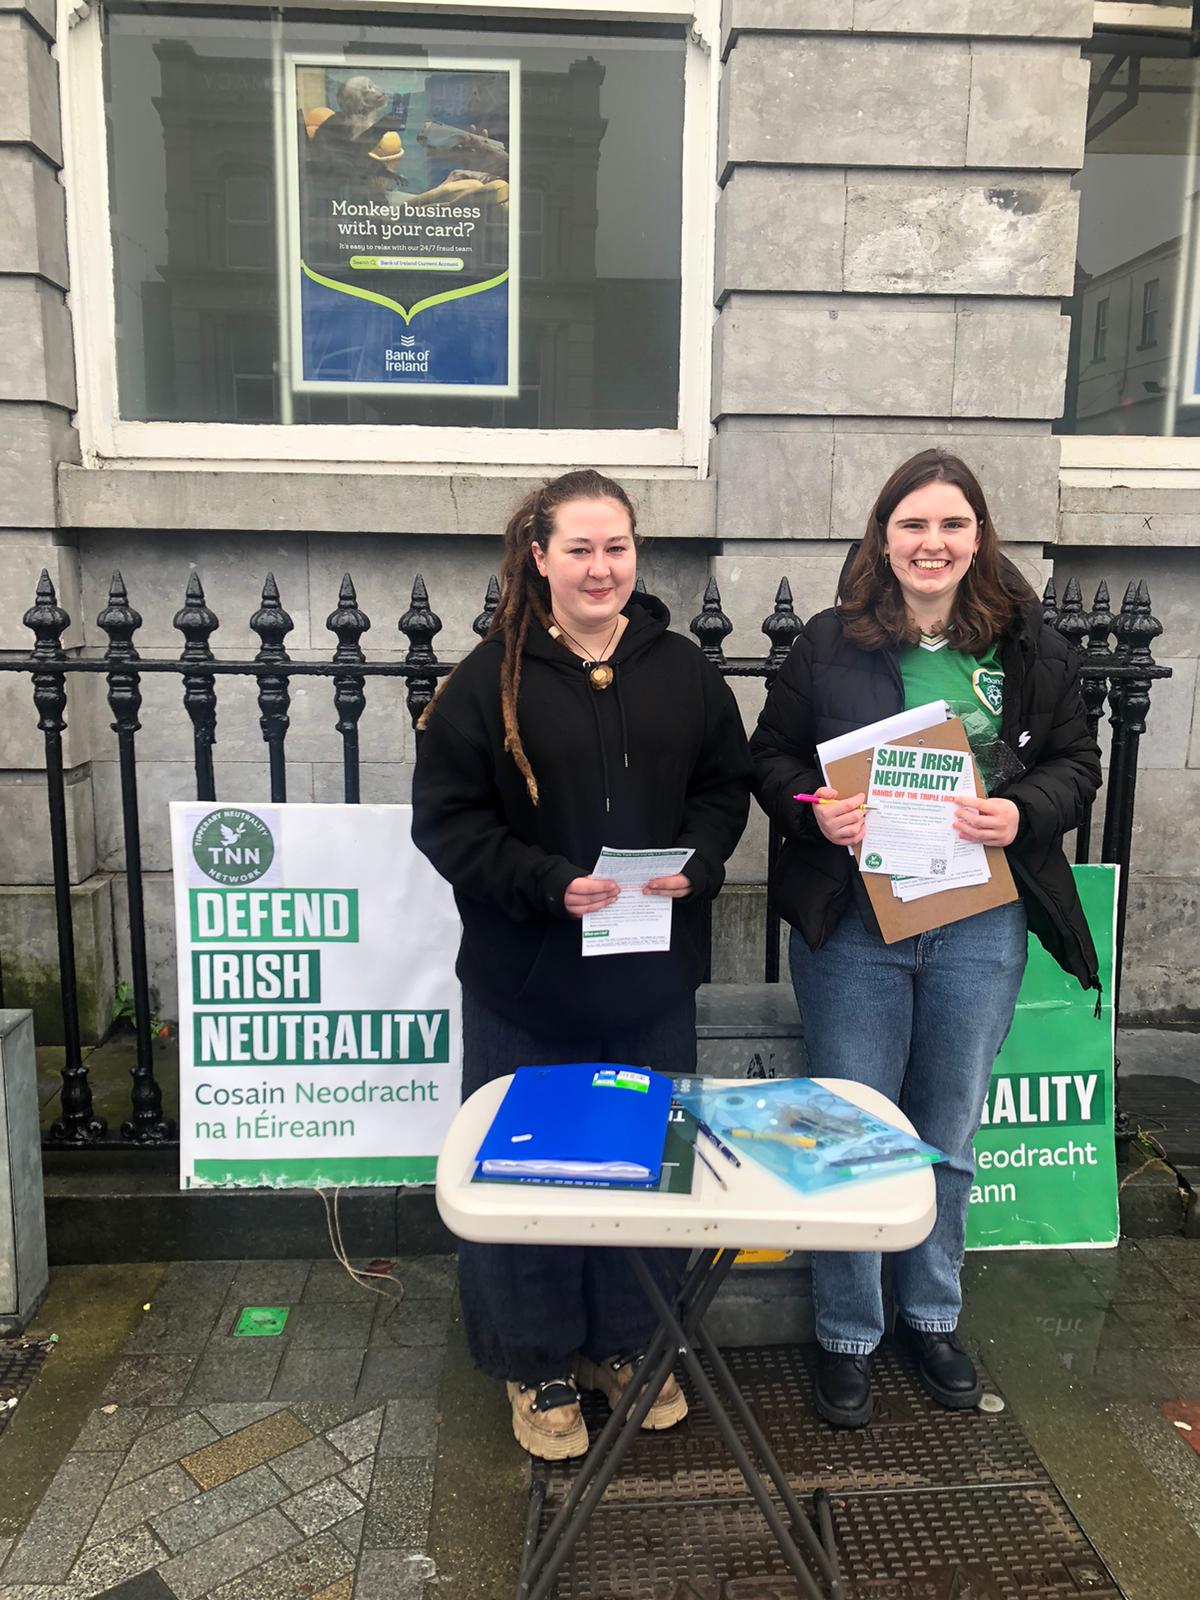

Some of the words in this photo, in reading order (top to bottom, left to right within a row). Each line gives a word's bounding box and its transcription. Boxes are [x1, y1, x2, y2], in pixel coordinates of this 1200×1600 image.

[332, 200, 400, 221] Monkey
[404, 202, 481, 218] business
[337, 220, 378, 235] with
[381, 222, 423, 240] your
[425, 222, 475, 237] card?
[339, 242, 349, 250] It's
[420, 244, 435, 252] 24/7
[436, 244, 455, 252] fraud
[385, 349, 415, 361] Bank
[416, 350, 430, 362] of
[385, 360, 428, 372] Ireland
[876, 748, 917, 769] SAVE
[921, 752, 964, 773] IRISH
[873, 769, 959, 791] NEUTRALITY
[872, 788, 893, 798] HANDS
[894, 790, 905, 799] OFF
[907, 791, 918, 800] THE
[920, 792, 940, 802] TRIPLE
[194, 812, 222, 847] TIPPERARY
[223, 810, 269, 836] NEUTRALITY
[207, 847, 260, 865] TNN
[208, 868, 262, 883] NETWORK
[198, 891, 350, 938] DEFEND
[199, 953, 310, 1000] IRISH
[200, 1012, 441, 1062] NEUTRALITY
[194, 1081, 285, 1106] Cosain
[295, 1079, 439, 1105] Neodracht
[195, 1120, 227, 1140] na
[236, 1109, 355, 1139] hÉireann
[973, 1140, 1098, 1169] eodracht
